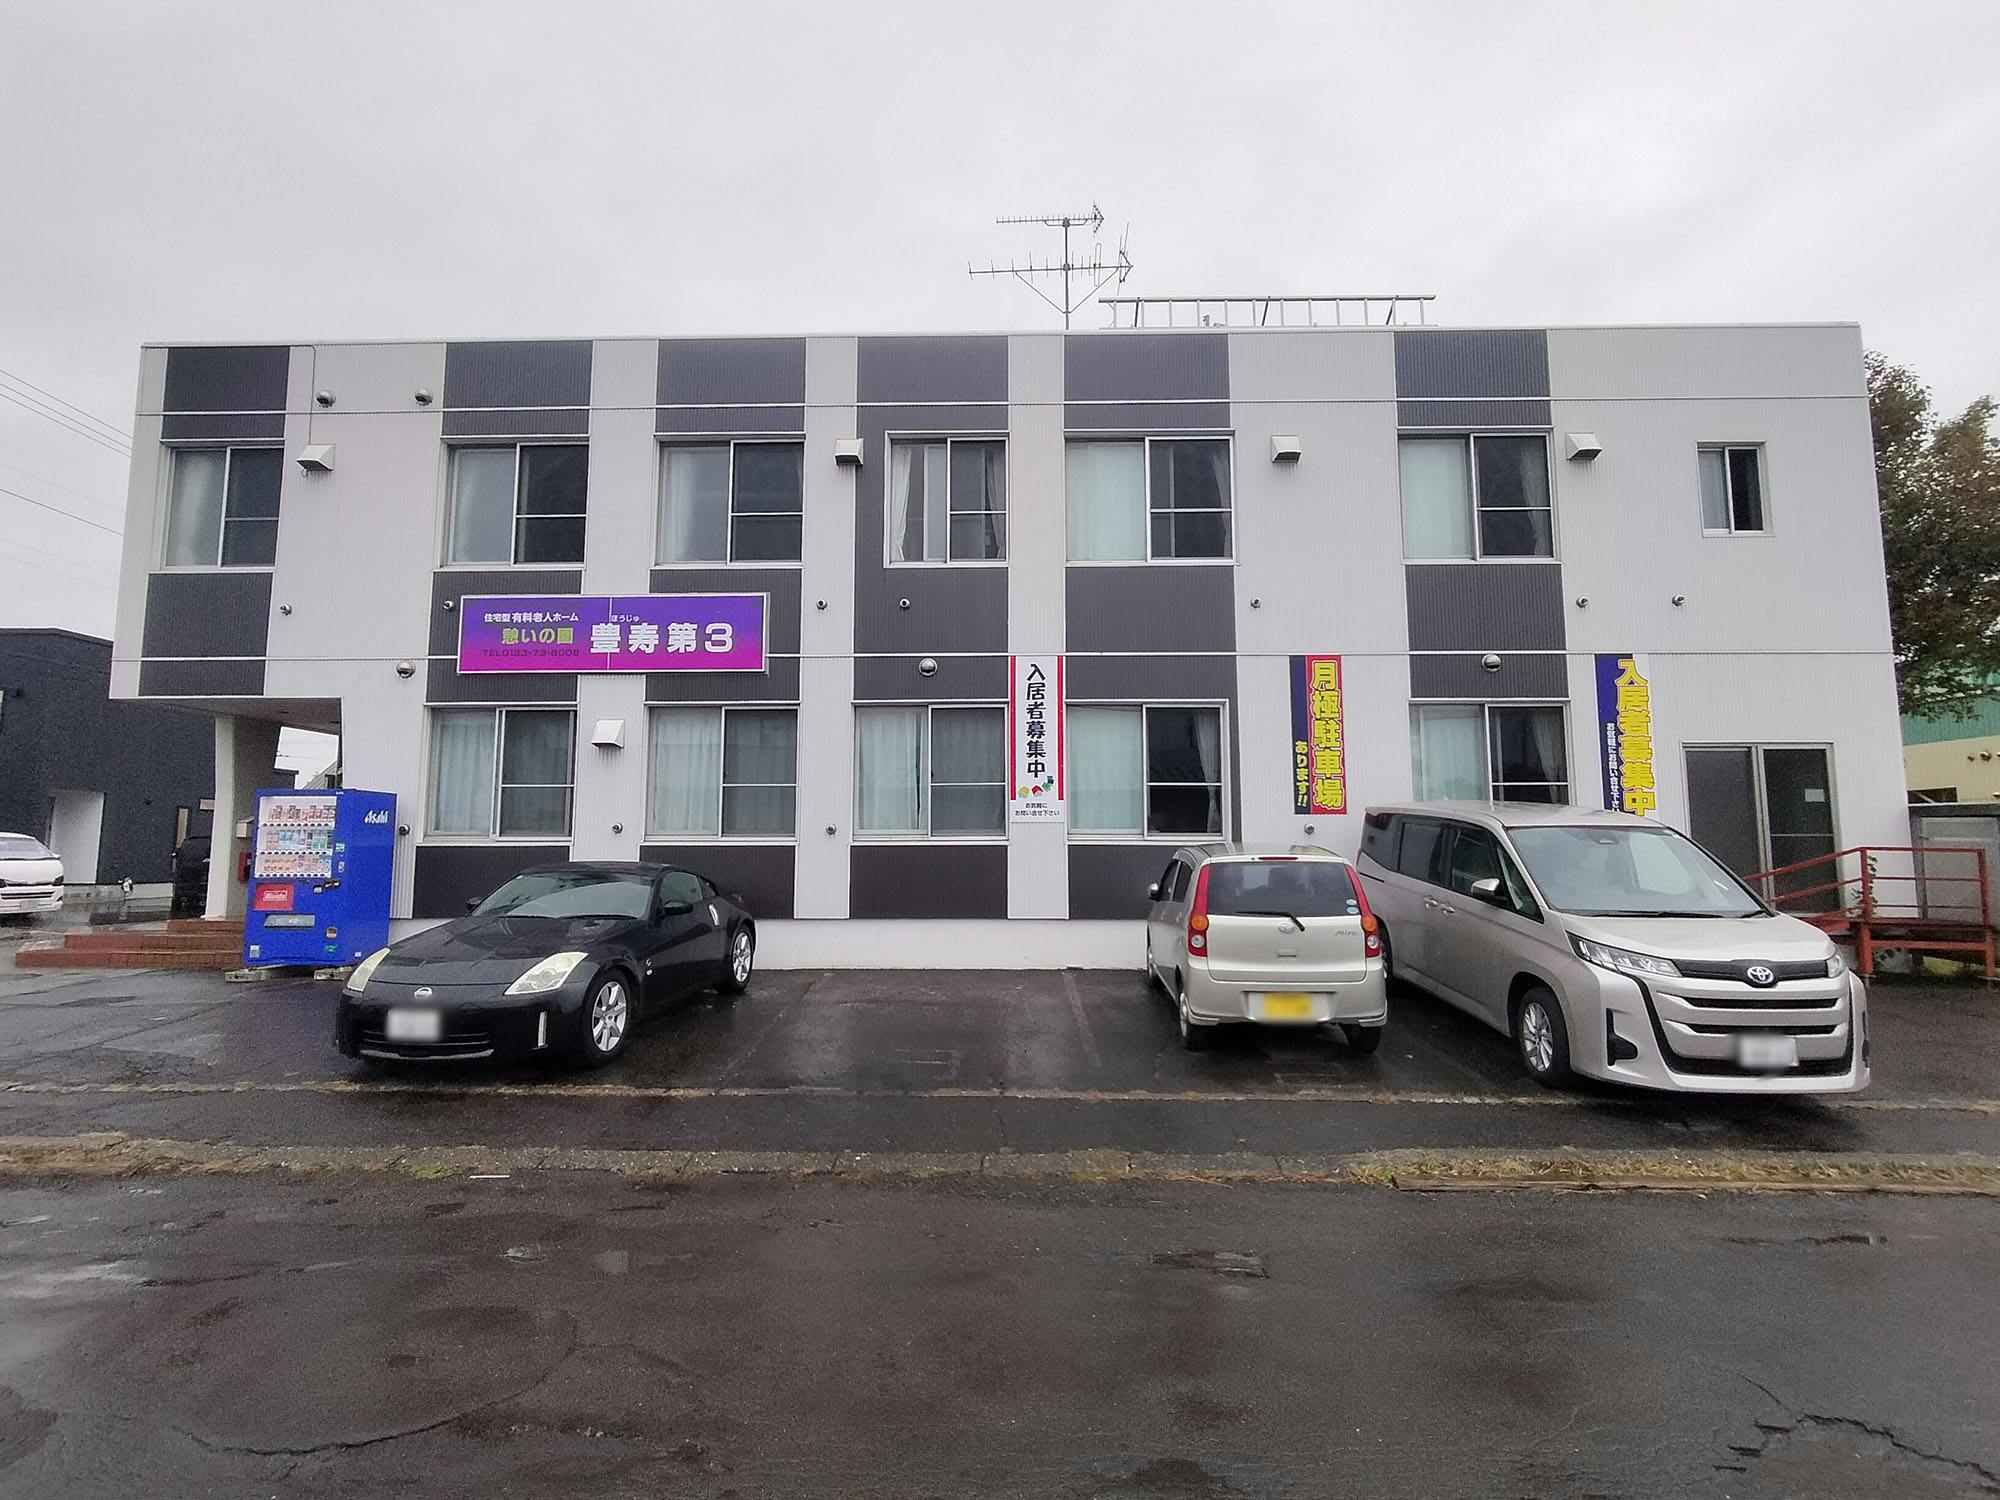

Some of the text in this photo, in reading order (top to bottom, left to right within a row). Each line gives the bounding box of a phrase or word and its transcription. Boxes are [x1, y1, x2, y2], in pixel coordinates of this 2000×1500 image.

[611, 614, 640, 623] ほうじゅ
[1026, 663, 1046, 778] 入居者募集中
[1311, 661, 1344, 809] 月極駐車場
[1615, 659, 1656, 816] 入居者募集中
[364, 809, 389, 824] Asahi
